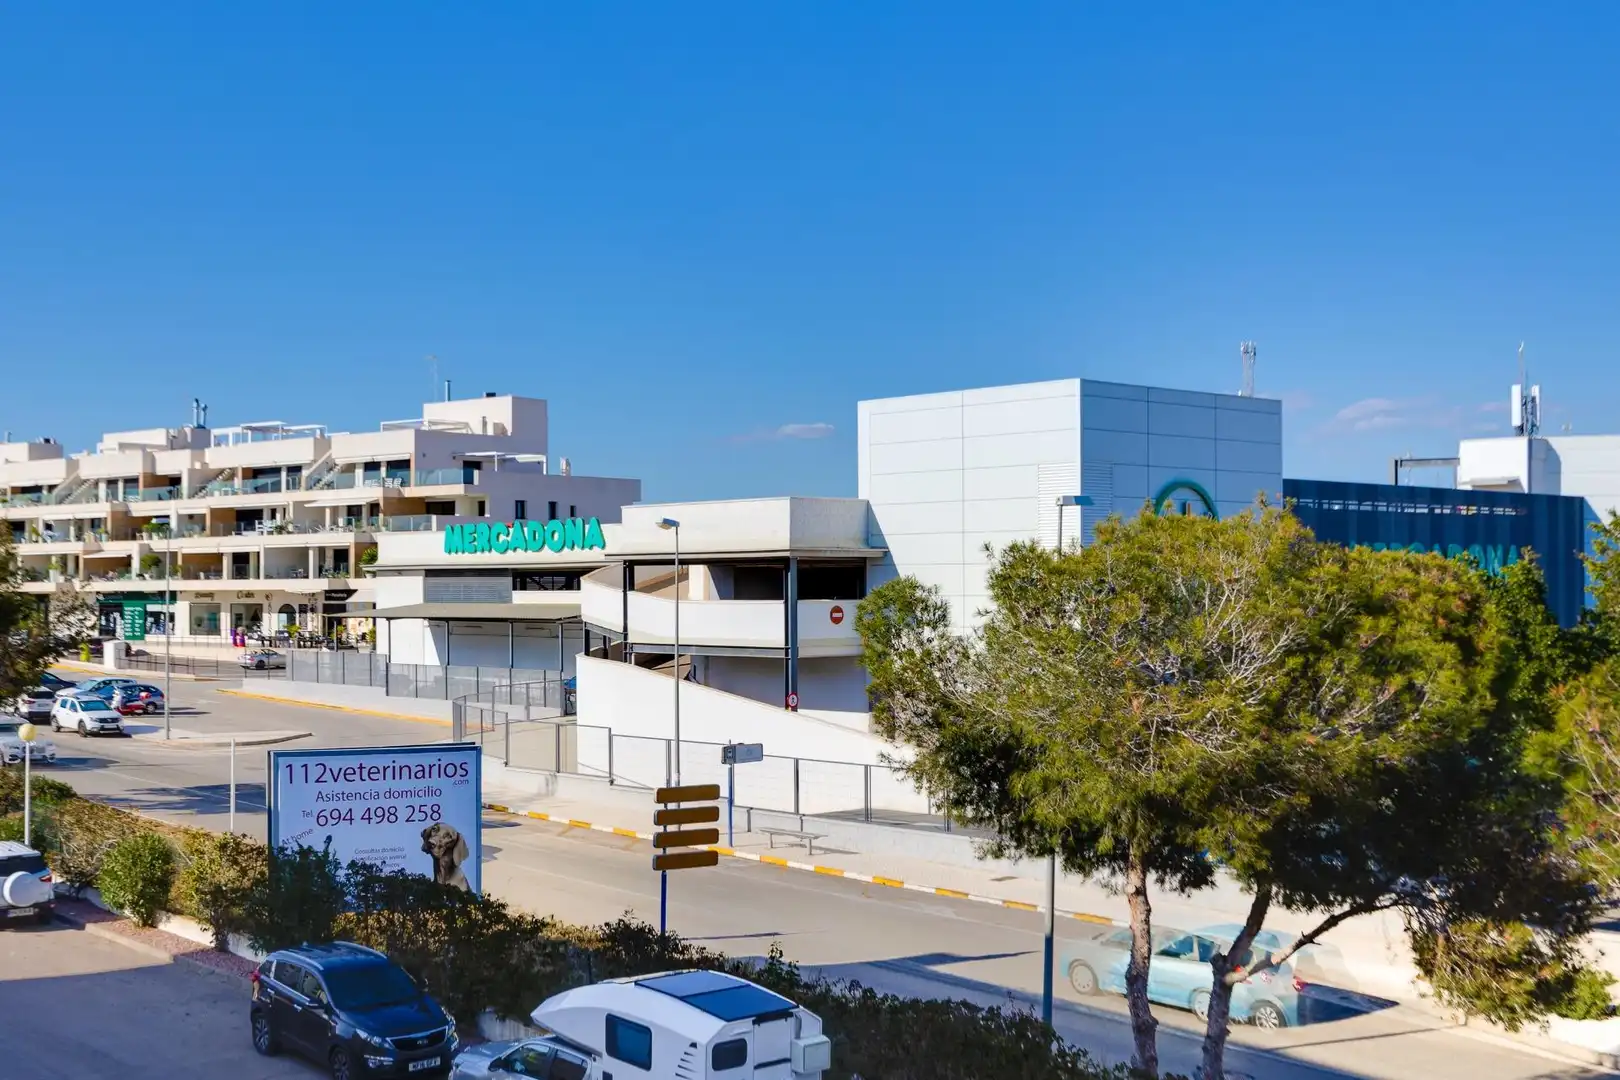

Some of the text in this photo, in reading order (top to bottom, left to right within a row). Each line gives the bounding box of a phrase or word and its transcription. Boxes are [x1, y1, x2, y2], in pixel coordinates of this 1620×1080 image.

[444, 516, 606, 554] MERCADONA
[285, 758, 469, 784] 112veterinarios
[453, 778, 469, 786] .com
[315, 785, 442, 803] Asistencia domicilio
[316, 808, 355, 827] 694
[360, 806, 398, 825] 498
[405, 803, 442, 823] 258
